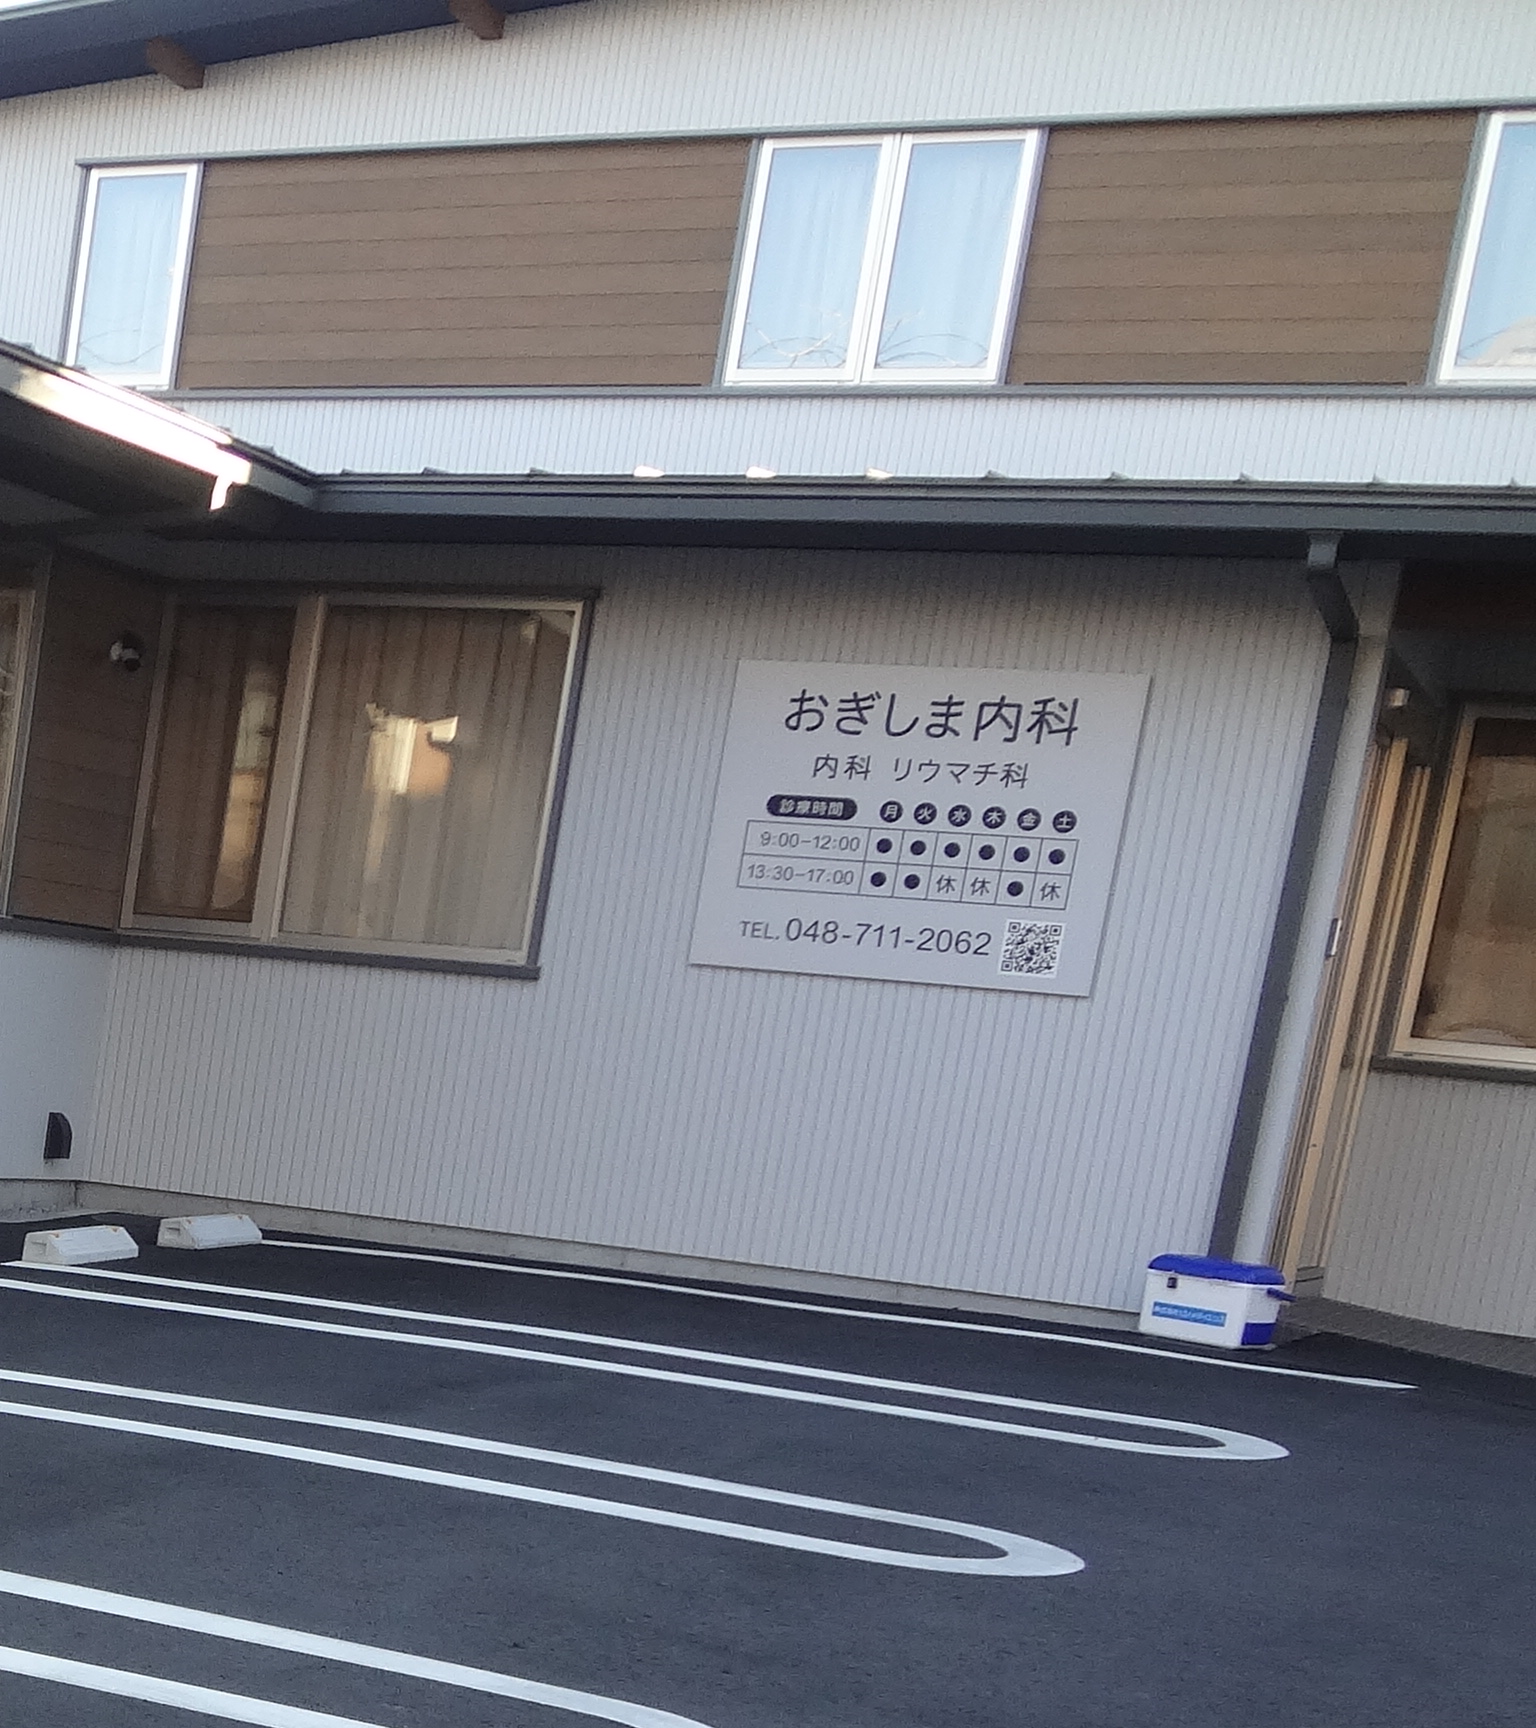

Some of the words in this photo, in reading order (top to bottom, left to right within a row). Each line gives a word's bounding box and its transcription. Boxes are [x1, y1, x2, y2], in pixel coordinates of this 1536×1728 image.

[785, 688, 1079, 746] おぎしま内科
[812, 753, 871, 781] 内科
[893, 757, 1029, 789] リウマチ科
[884, 804, 898, 819] 月
[917, 806, 933, 820] 火
[951, 808, 968, 822] 水
[987, 810, 1003, 825] 木
[1021, 812, 1038, 827] 金
[1056, 814, 1072, 829] 土
[936, 874, 957, 894] 休
[970, 877, 991, 896] 休
[1039, 882, 1061, 901] 休
[740, 921, 779, 940] TEL.
[785, 918, 991, 956] 048-711-2062
